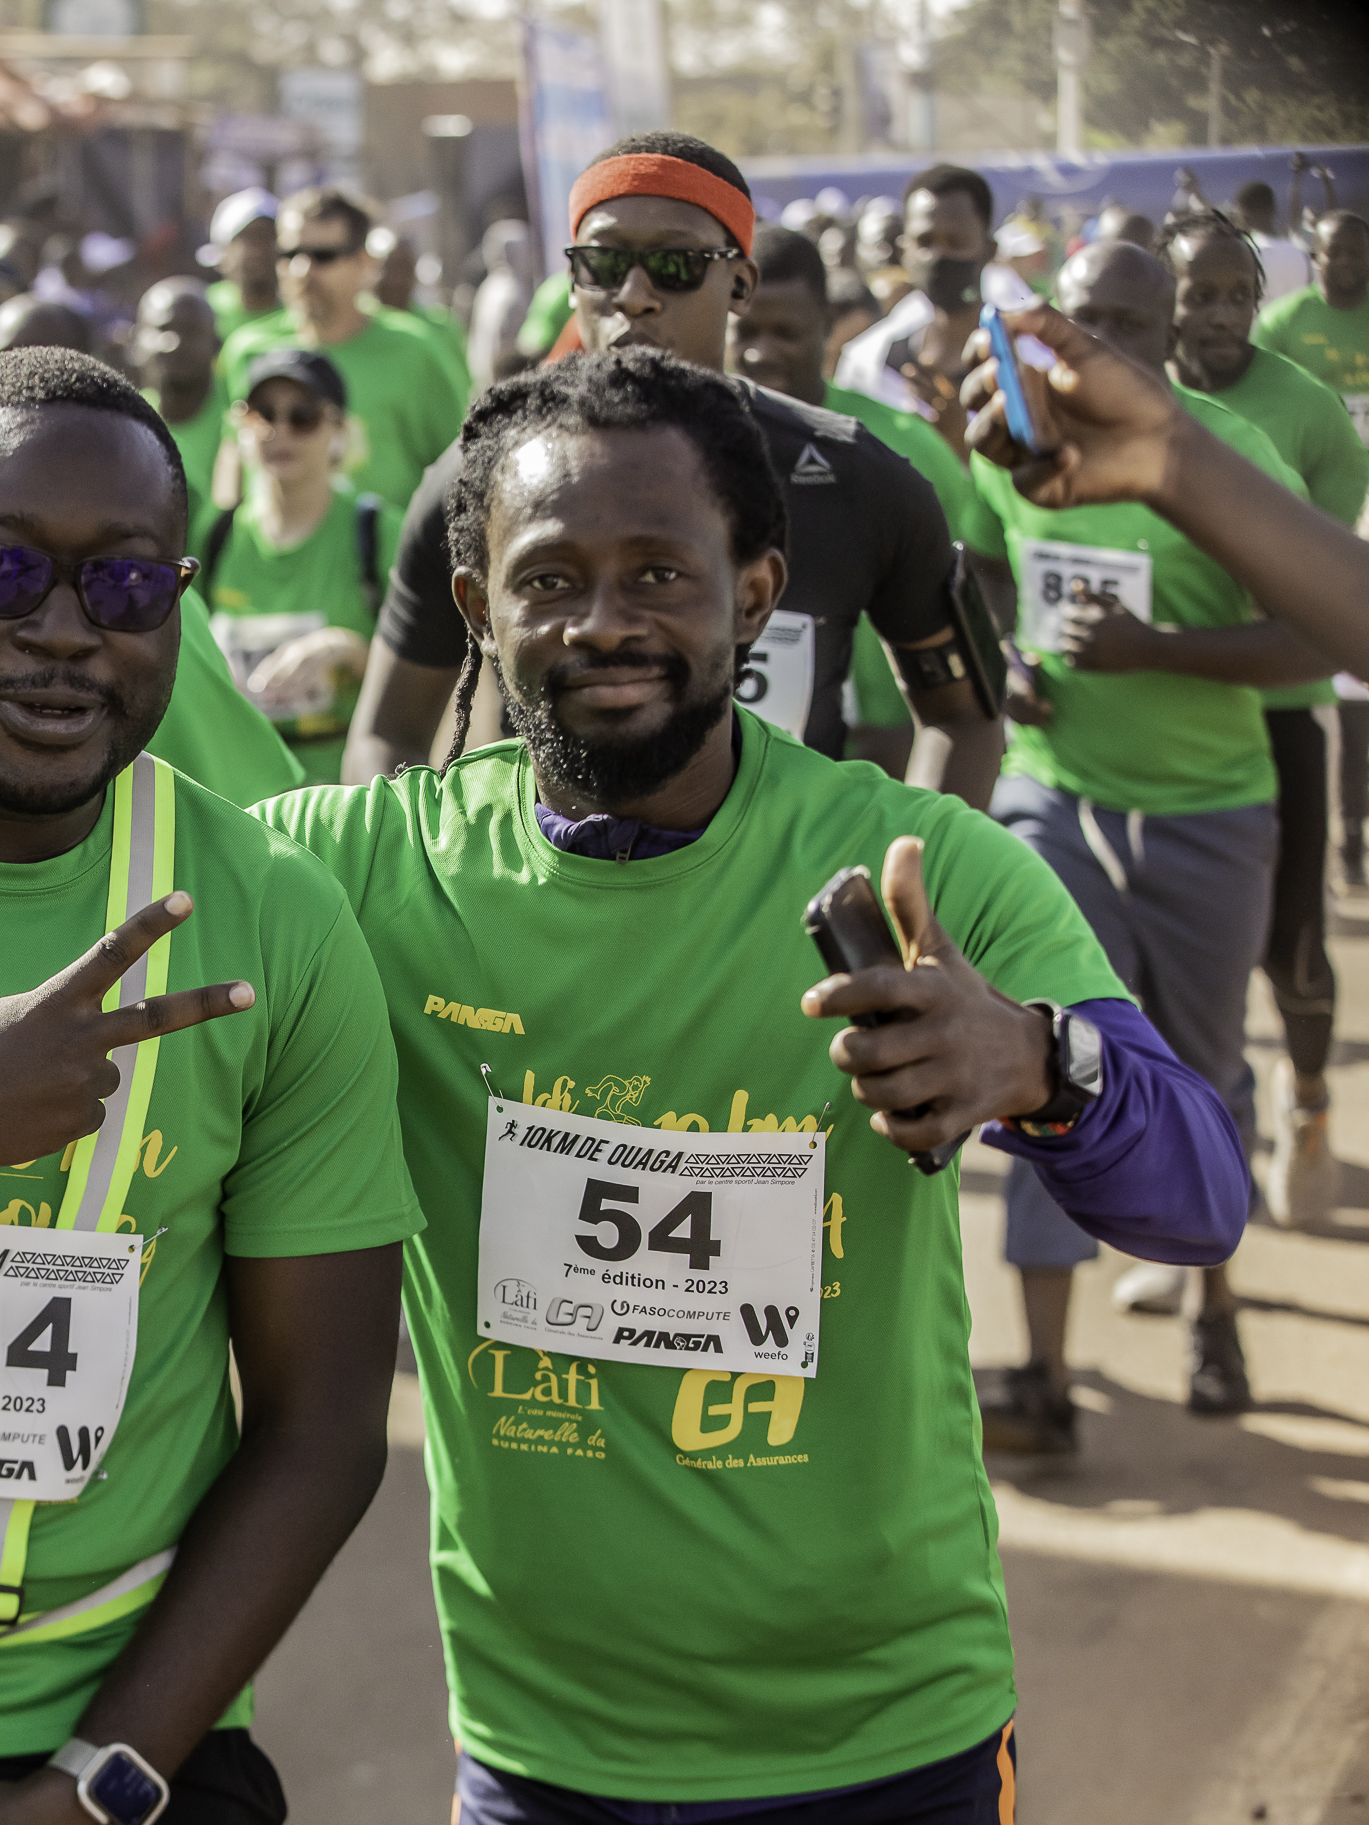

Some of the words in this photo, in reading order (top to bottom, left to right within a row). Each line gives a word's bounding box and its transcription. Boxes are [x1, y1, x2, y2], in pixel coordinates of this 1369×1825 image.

[423, 994, 525, 1035] PANGA
[519, 1124, 582, 1155] 10KM
[574, 1136, 609, 1163] DE
[607, 1143, 685, 1175] OUAGA
[574, 1177, 722, 1271] 54
[562, 1263, 596, 1279] 7ème
[601, 1270, 667, 1292] édition
[684, 1278, 730, 1296] 2023
[545, 1297, 605, 1331] GA
[631, 1304, 732, 1322] FASOCOMPUTE
[612, 1327, 725, 1354] PANGA
[754, 1351, 789, 1361] weefo
[1, 1395, 47, 1414] 2023
[672, 1369, 805, 1451] GA
[491, 1438, 559, 1455] BURKINA
[566, 1447, 607, 1460] FASO
[492, 1416, 580, 1444] Naturelle
[587, 1429, 606, 1449] du
[676, 1453, 723, 1470] Générale
[725, 1454, 745, 1469] des
[746, 1452, 809, 1468] Assurances
